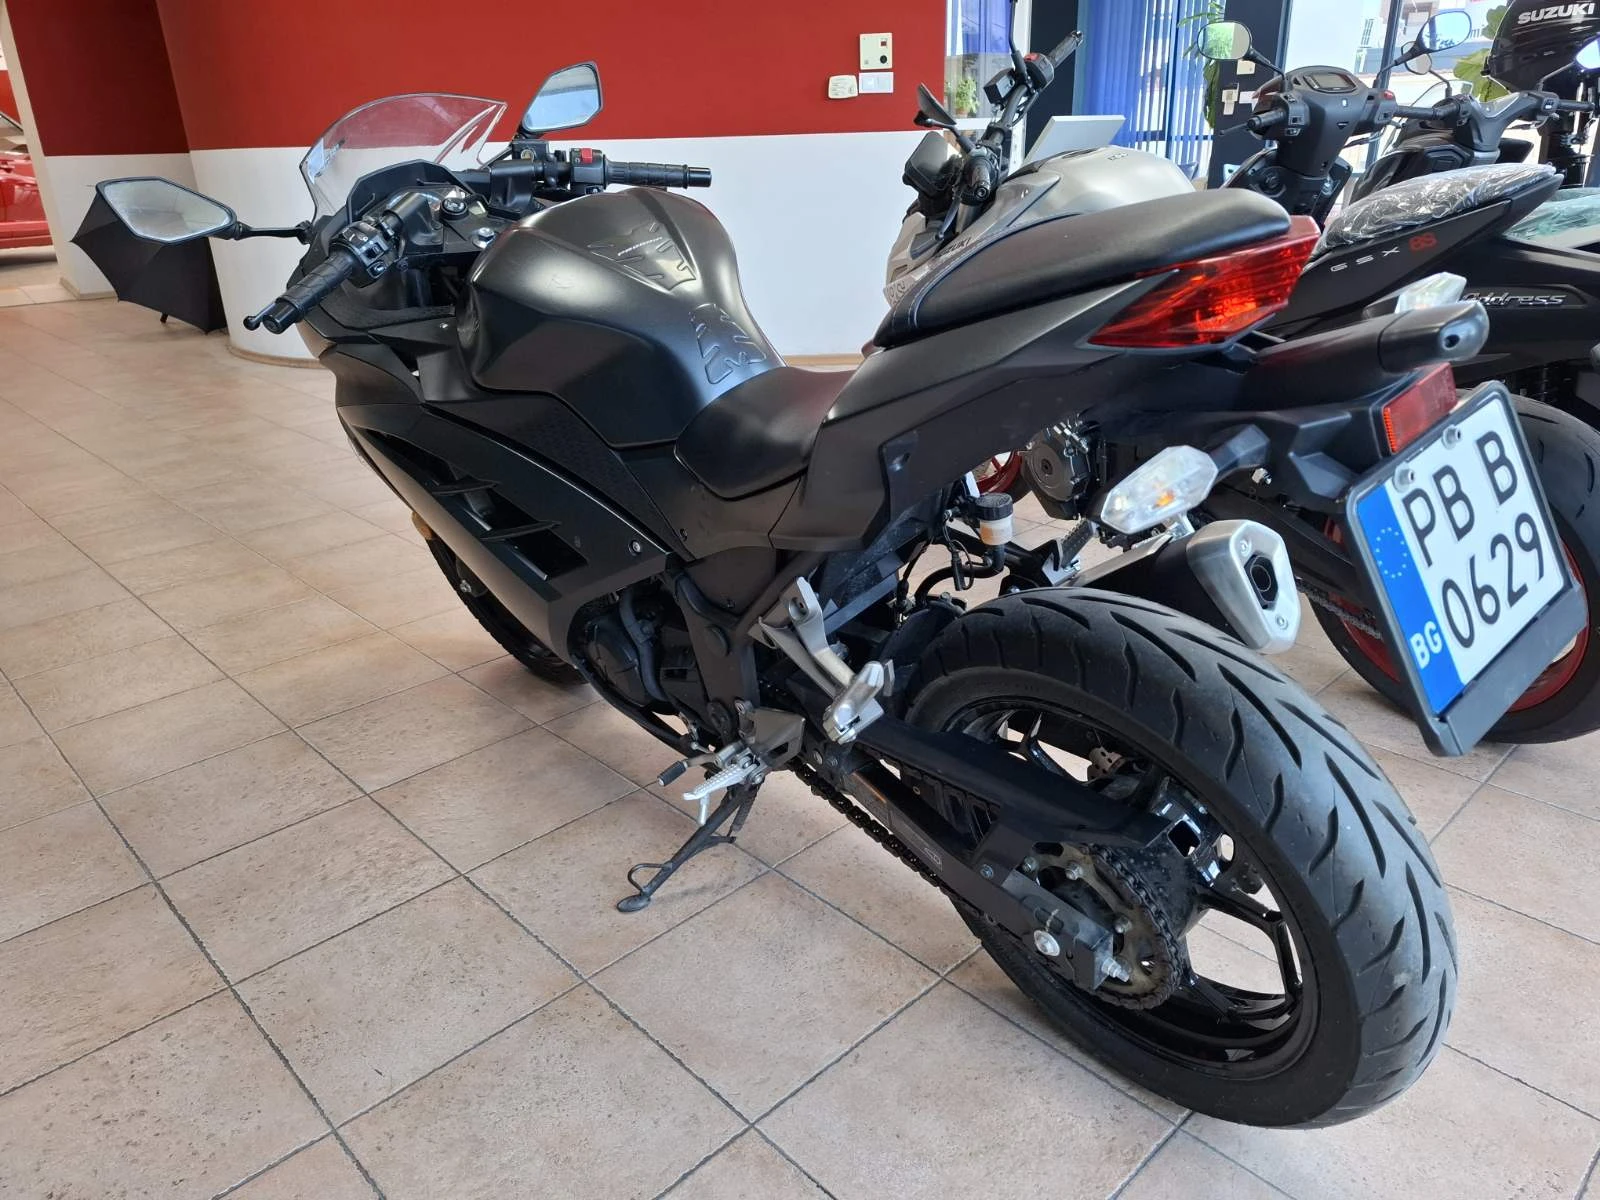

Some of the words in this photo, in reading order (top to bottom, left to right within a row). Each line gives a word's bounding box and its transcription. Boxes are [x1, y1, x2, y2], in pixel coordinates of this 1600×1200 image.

[1518, 3, 1596, 25] SUZUKI
[1441, 512, 1545, 649] 0629
[1409, 620, 1443, 670] BG
